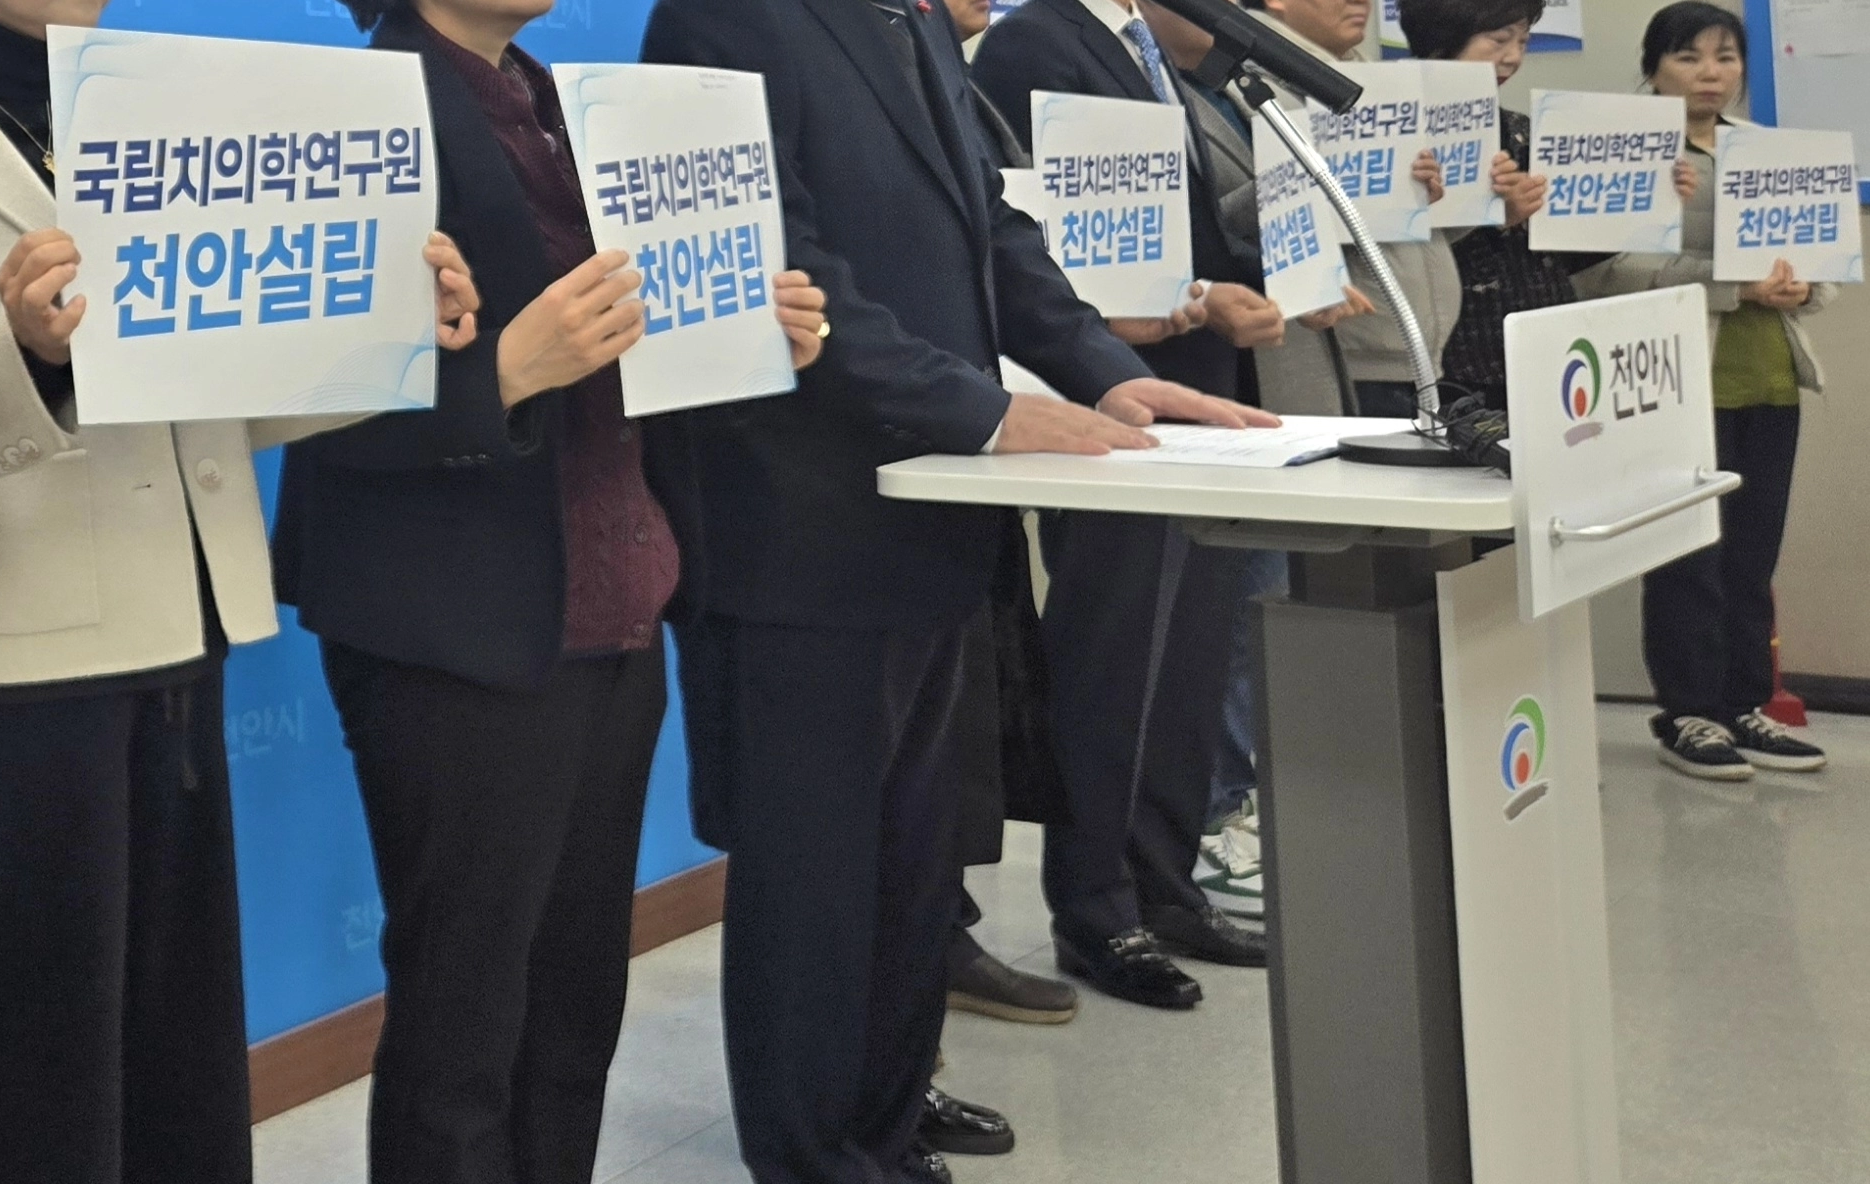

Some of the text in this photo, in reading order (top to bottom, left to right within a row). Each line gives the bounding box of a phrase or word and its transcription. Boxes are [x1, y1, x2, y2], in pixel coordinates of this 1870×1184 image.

[73, 126, 422, 214] 국립치의학연구원
[1042, 151, 1182, 198] 국립치의학연구원
[1536, 130, 1681, 166] 국립치의학연구원
[595, 140, 772, 226] 국립치의학연구원
[1547, 169, 1657, 217] 천안설립
[1721, 164, 1853, 200] 국립치의학연구원
[1061, 204, 1164, 268] 천안설립
[1736, 202, 1840, 248] 천안설립
[114, 218, 378, 339] 천안설립
[636, 222, 767, 336] 천안설립
[1609, 333, 1682, 421] 천안시
